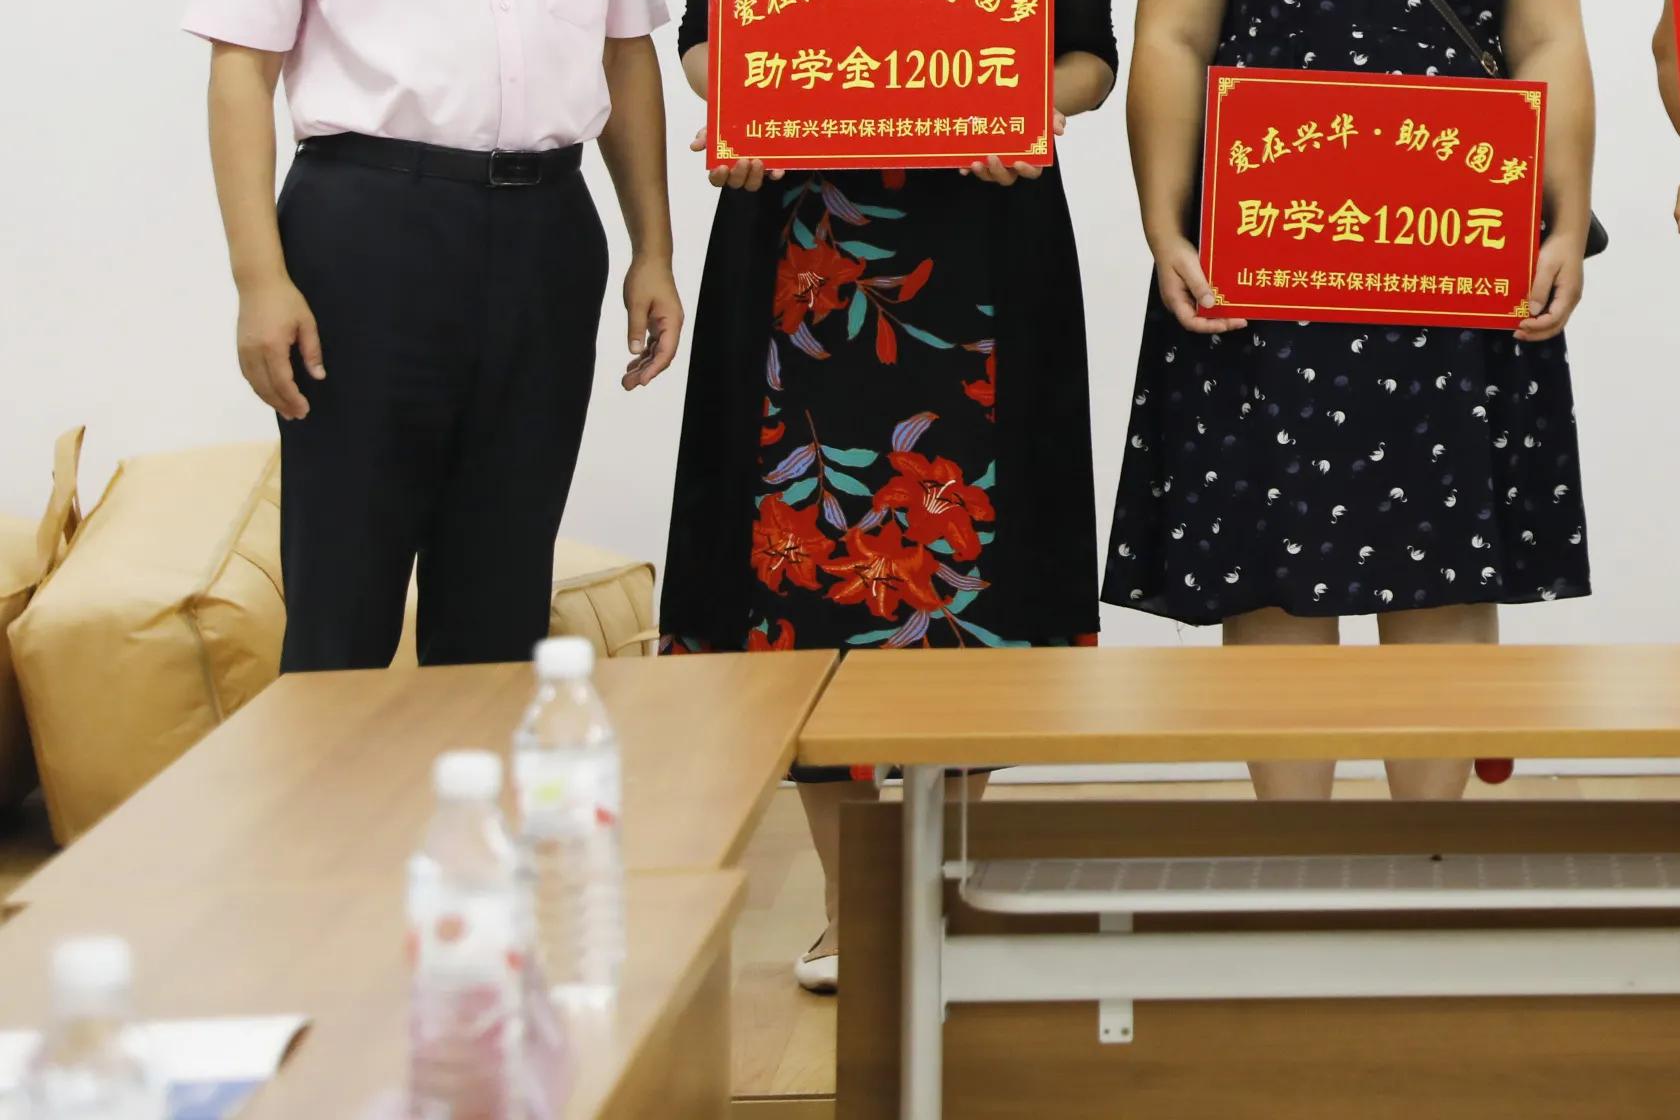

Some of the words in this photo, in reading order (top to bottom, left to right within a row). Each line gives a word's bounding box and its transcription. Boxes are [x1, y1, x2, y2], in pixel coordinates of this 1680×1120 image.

[743, 45, 1019, 90] 助学金1200元
[745, 115, 1026, 139] 山东新兴华环保科技材料有限公司
[1236, 198, 1506, 250] 助学金1200元
[1237, 267, 1510, 297] 山东新兴华环保科技材料有限公司
